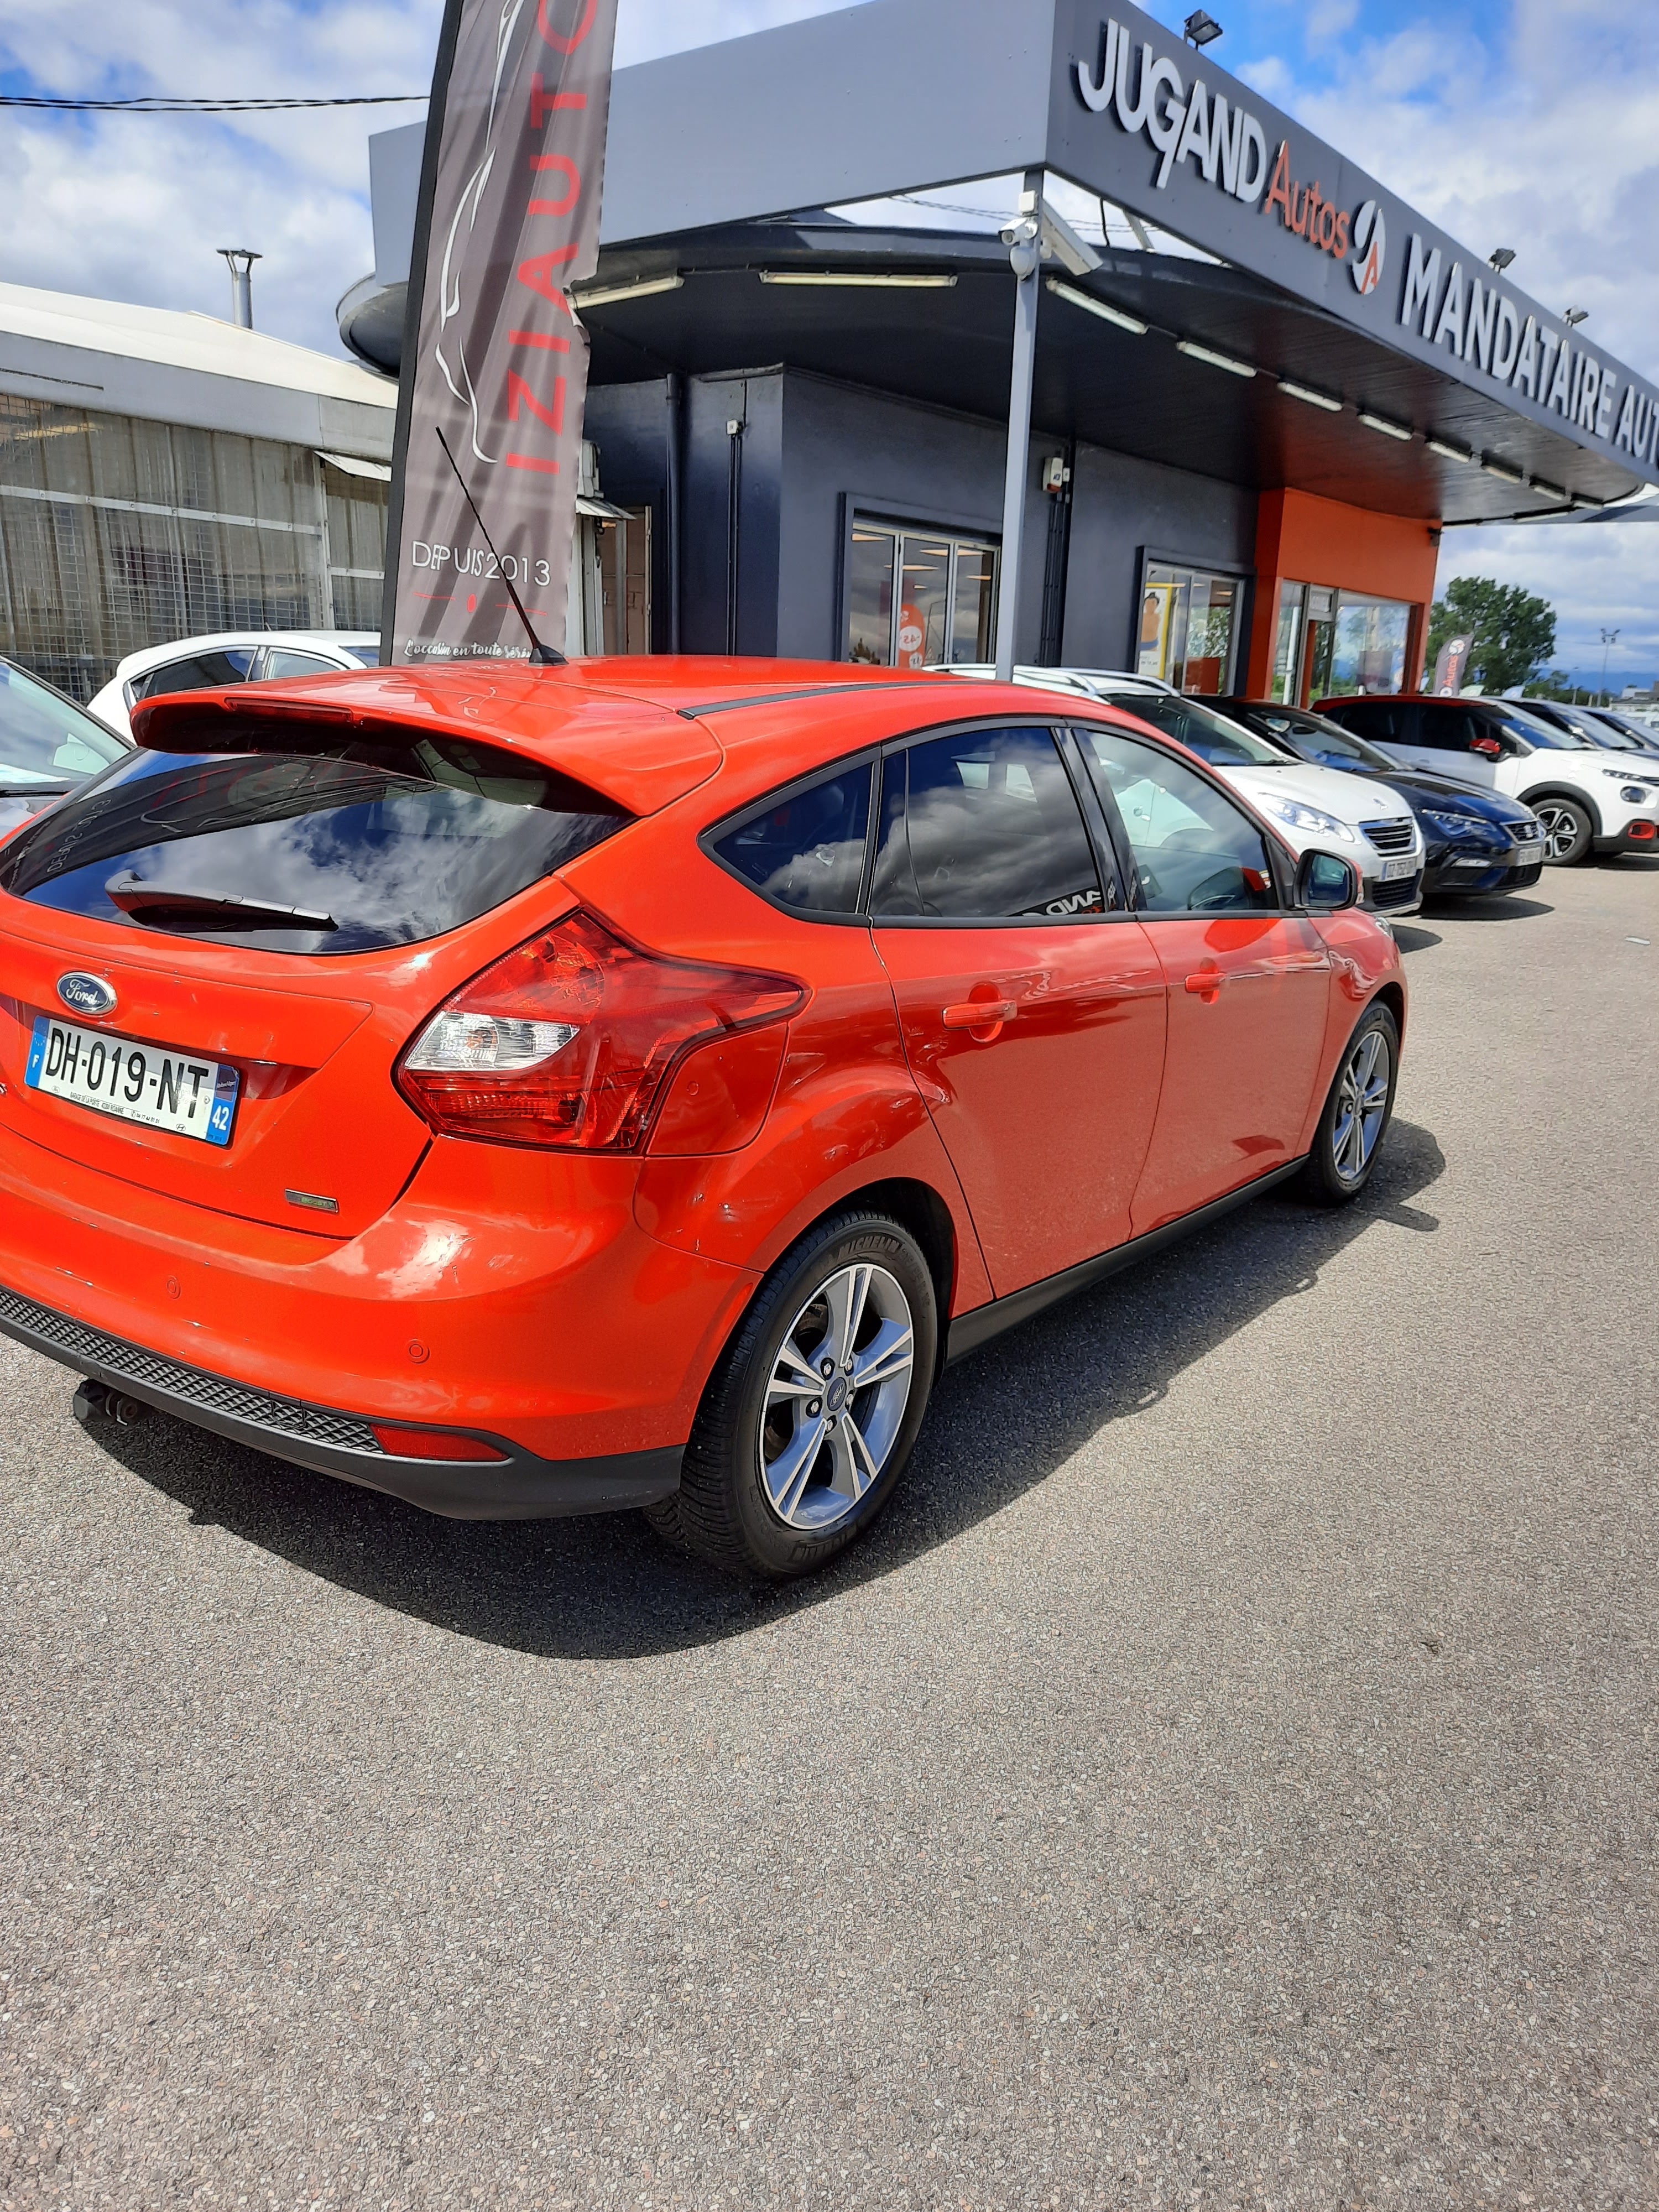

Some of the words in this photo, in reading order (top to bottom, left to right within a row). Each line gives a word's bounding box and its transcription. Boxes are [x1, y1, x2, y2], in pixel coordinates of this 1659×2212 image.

[1078, 18, 1267, 203] JUGAND
[1265, 140, 1349, 259] Autos
[1401, 233, 1616, 439] MANDATAIRE
[412, 541, 484, 577] DEPUIS
[484, 552, 550, 586] 2013
[453, 646, 470, 656] en
[471, 641, 503, 657] toute
[66, 979, 100, 1005] Ford
[32, 1054, 40, 1068] F
[46, 1027, 209, 1118] DH-019-NT
[212, 1105, 230, 1131] 42
[838, 1235, 901, 1260] MICHELIN
